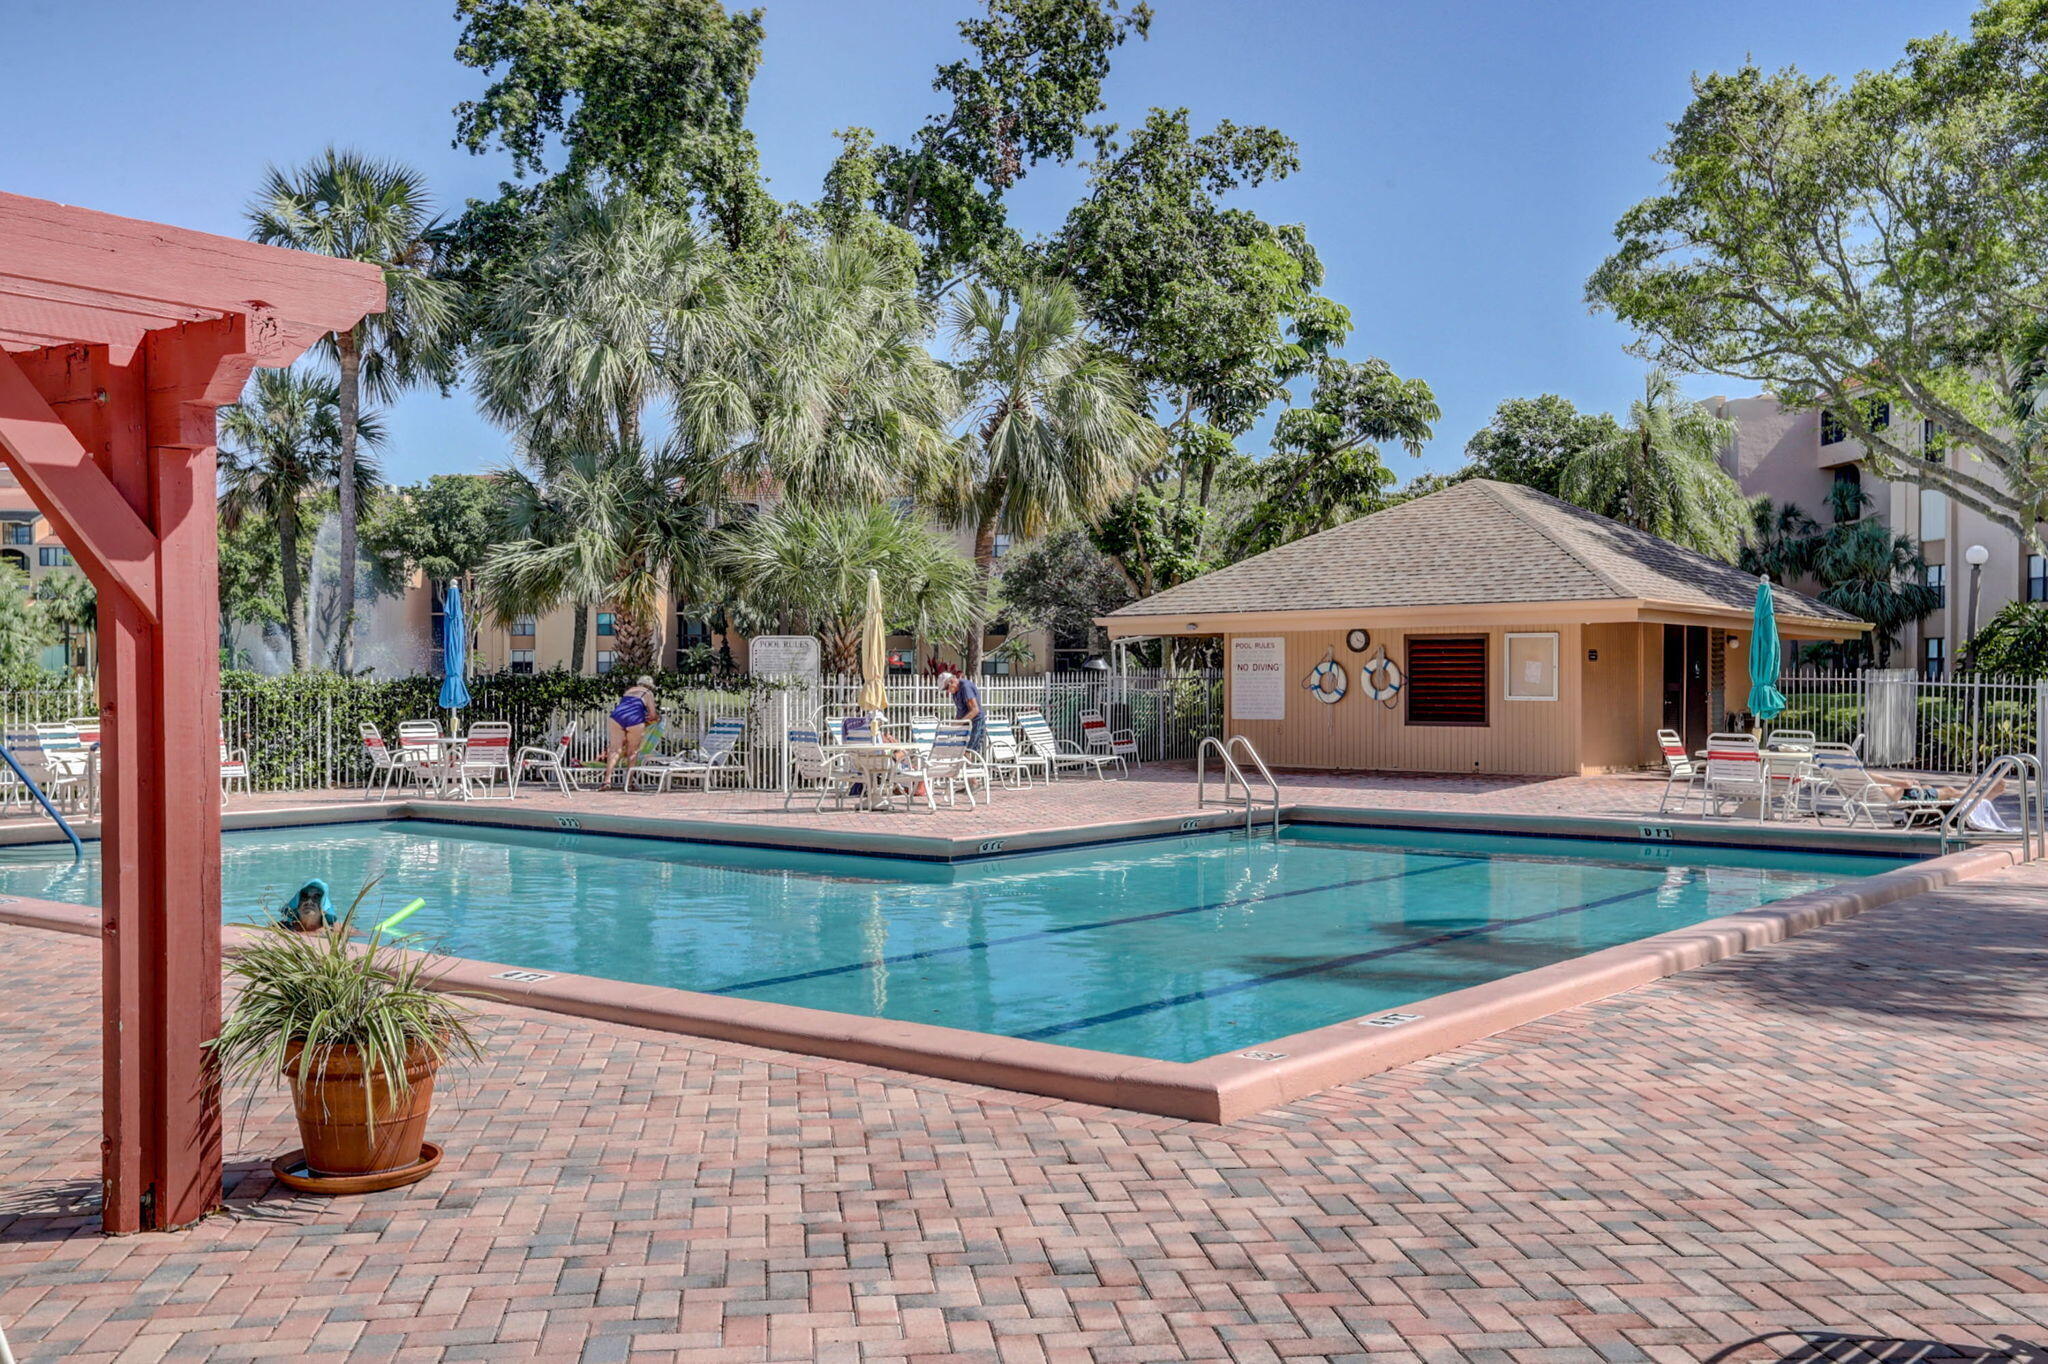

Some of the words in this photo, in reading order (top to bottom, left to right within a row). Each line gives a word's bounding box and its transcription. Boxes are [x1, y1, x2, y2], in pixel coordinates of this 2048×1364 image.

[760, 640, 780, 648] POOL
[783, 640, 809, 648] RULES
[1237, 663, 1249, 672] NO
[1252, 663, 1280, 672] DIVING
